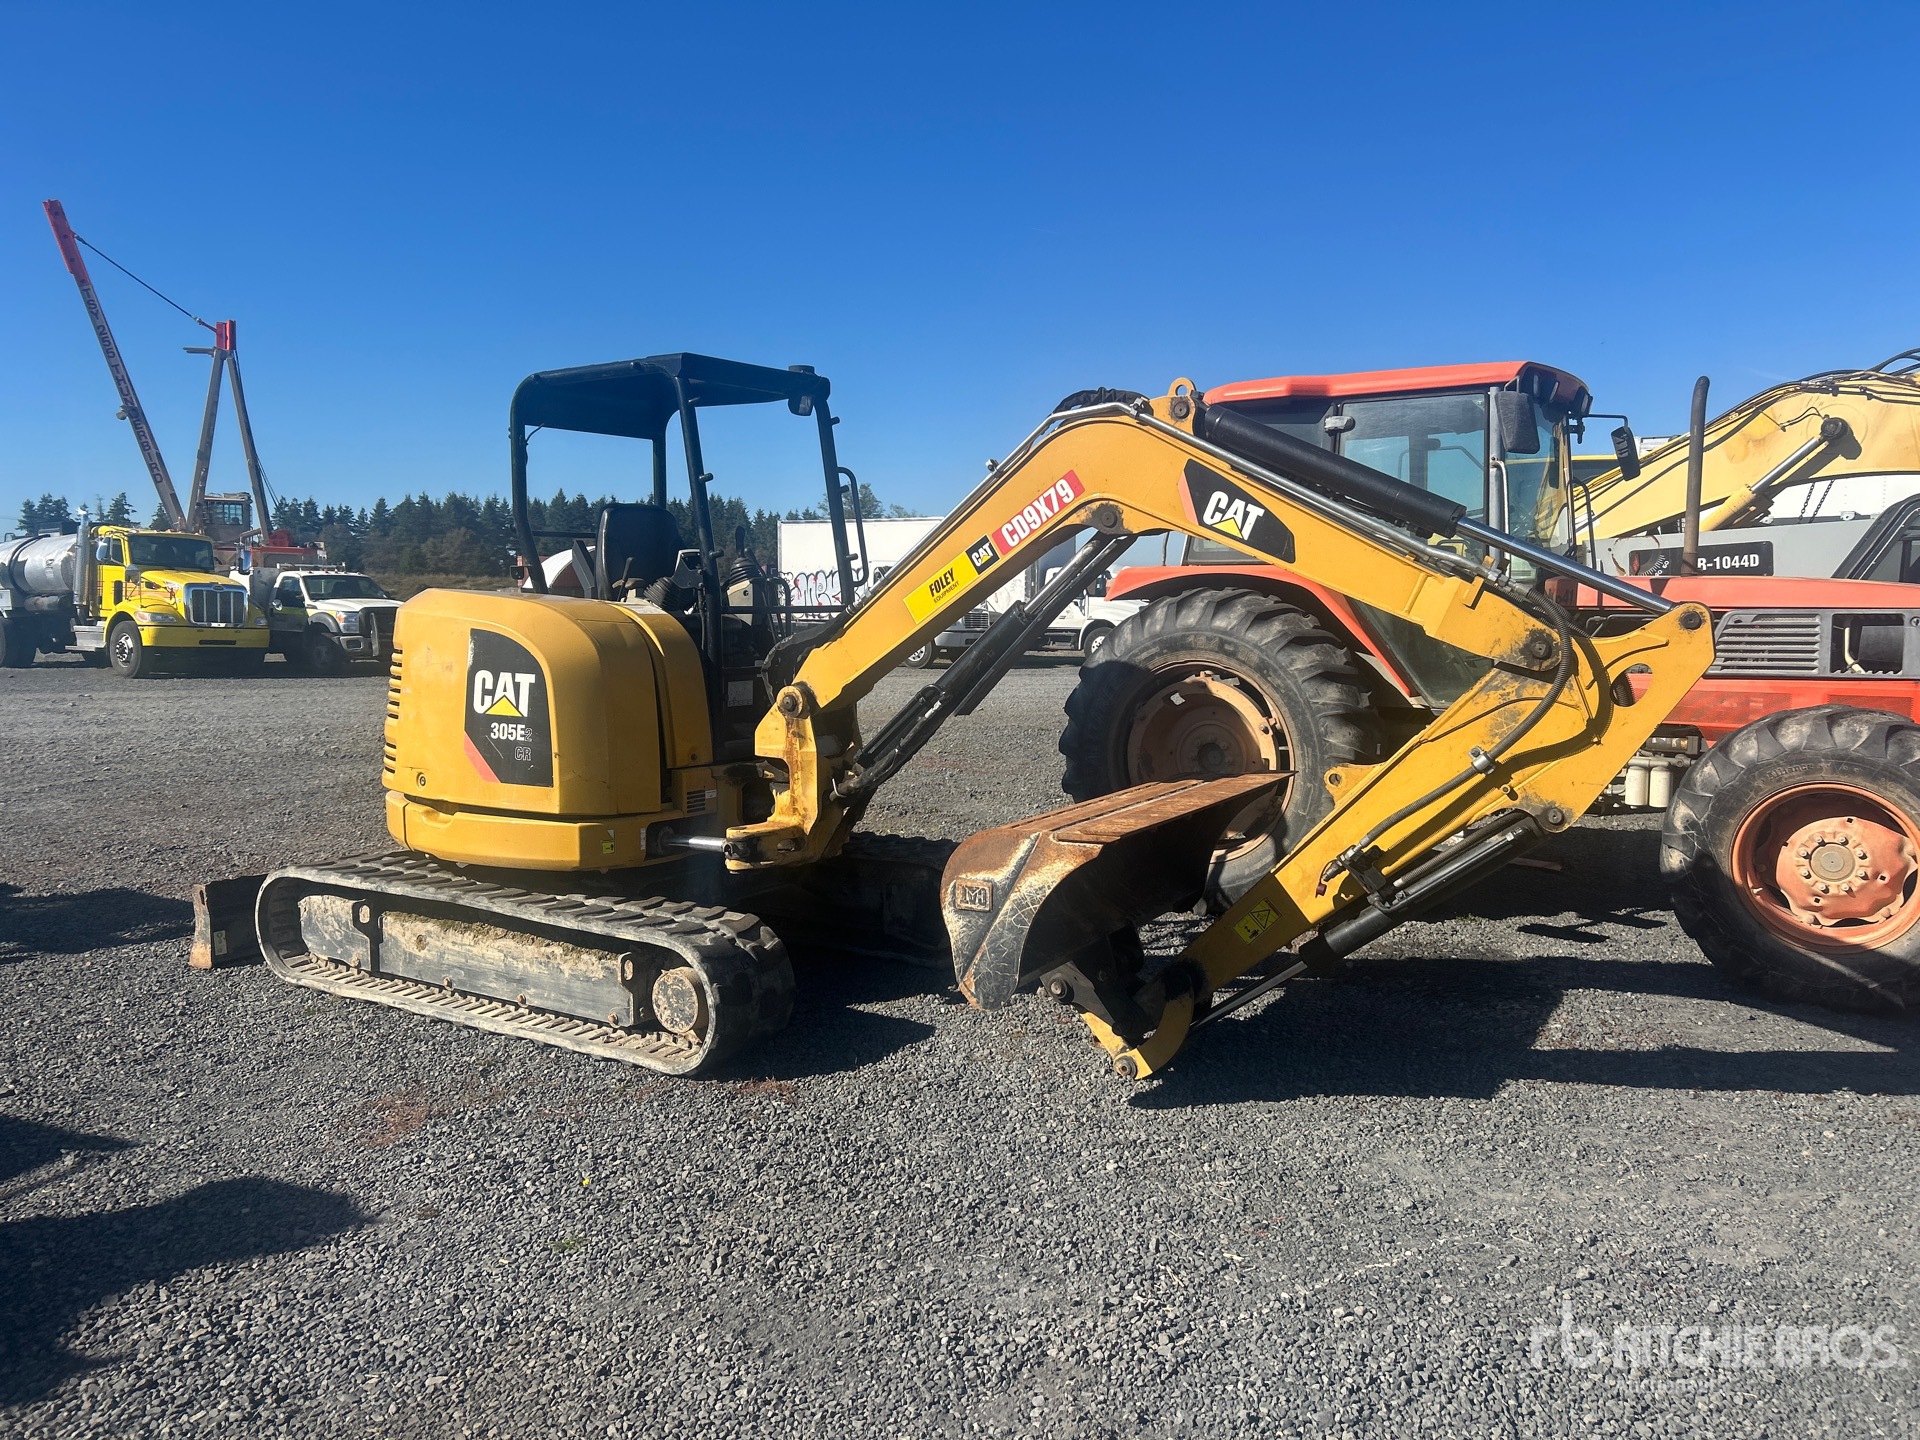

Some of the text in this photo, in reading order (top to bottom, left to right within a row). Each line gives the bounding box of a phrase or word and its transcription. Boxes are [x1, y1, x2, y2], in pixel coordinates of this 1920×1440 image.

[97, 324, 116, 359] 255
[111, 363, 163, 484] THUNDERBIRD
[1001, 479, 1075, 547] CD9X79
[1203, 491, 1265, 540] CAT
[971, 542, 995, 567] CAT
[929, 567, 955, 597] FOLEY
[933, 581, 960, 604] EQUIPMENT
[473, 670, 536, 717] CAT
[514, 746, 532, 761] CR
